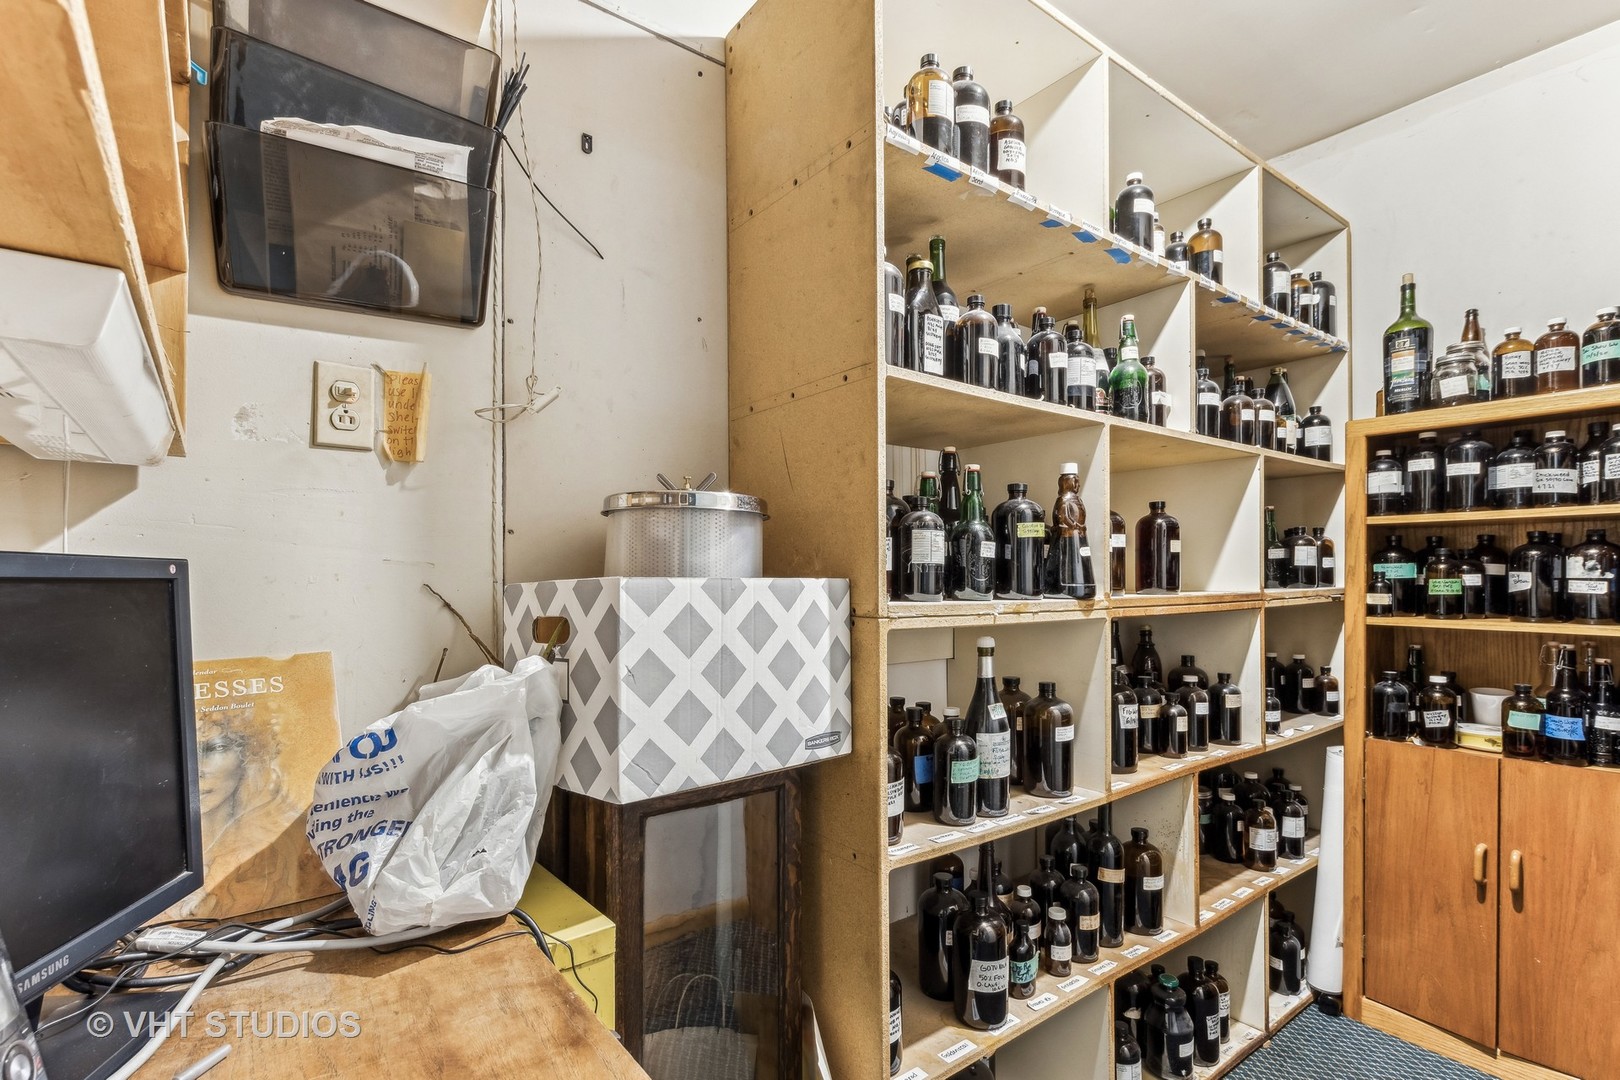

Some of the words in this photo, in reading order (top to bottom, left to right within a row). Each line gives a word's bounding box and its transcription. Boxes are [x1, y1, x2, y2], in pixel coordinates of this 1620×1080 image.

[388, 388, 406, 397] use
[387, 437, 400, 446] on
[194, 676, 285, 700] ESSES
[200, 703, 229, 714] Seddon
[230, 701, 255, 711] Boulet
[347, 809, 375, 824] the
[17, 953, 71, 995] SAMSUNG
